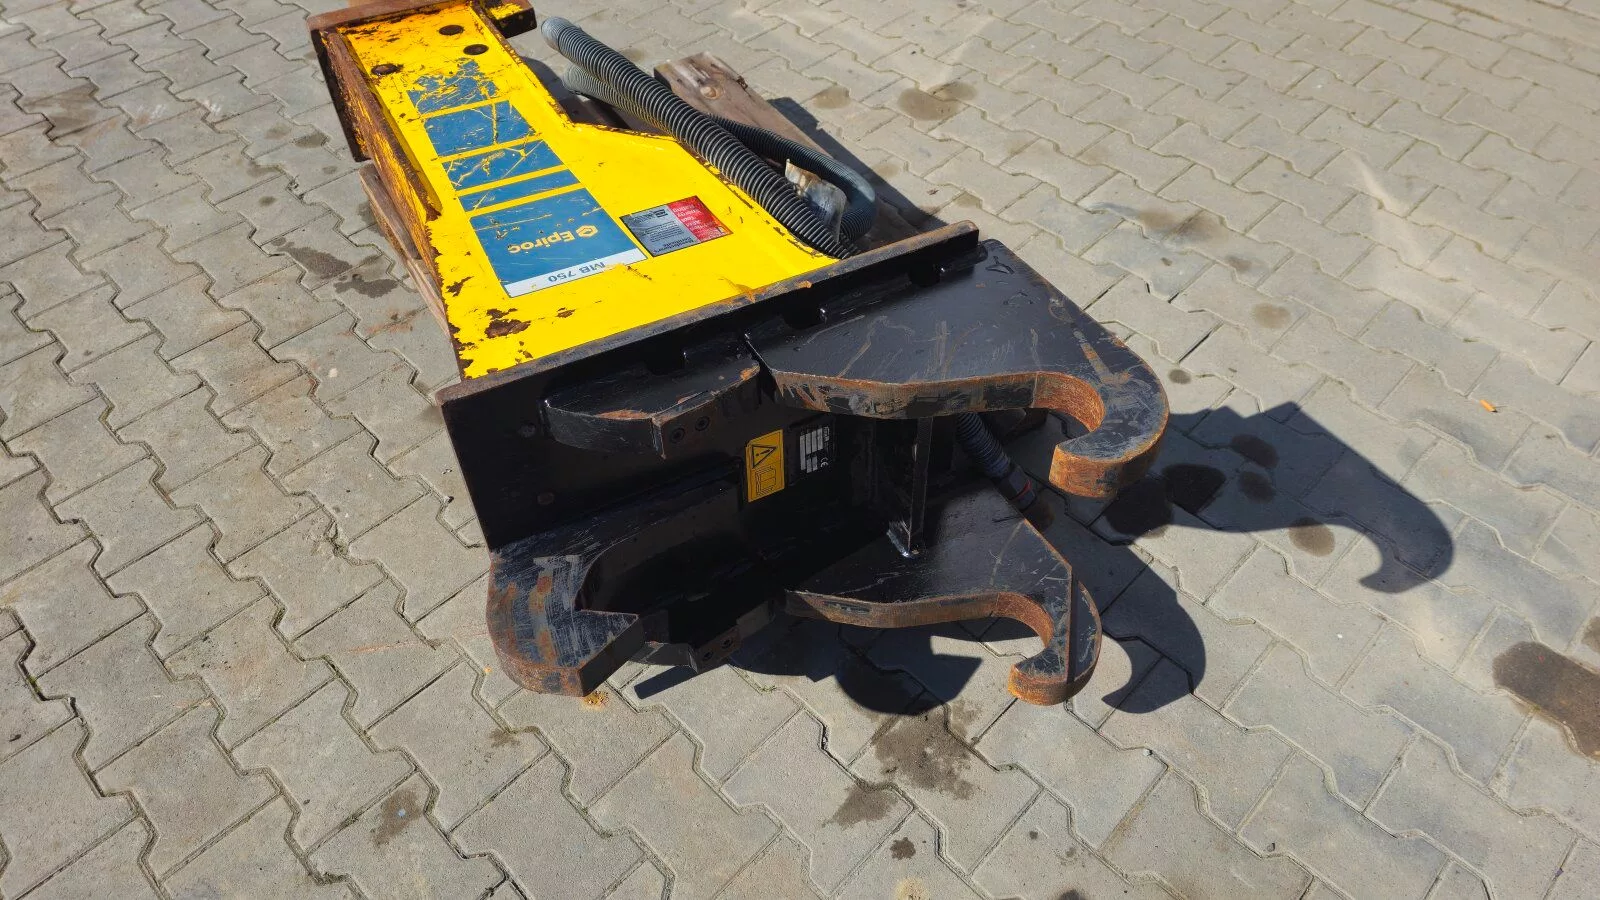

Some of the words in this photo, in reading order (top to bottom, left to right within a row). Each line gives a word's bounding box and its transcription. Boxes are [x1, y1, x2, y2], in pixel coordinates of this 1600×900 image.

[508, 230, 575, 254] Epiroc
[579, 261, 605, 274] MB
[548, 270, 577, 282] 750
